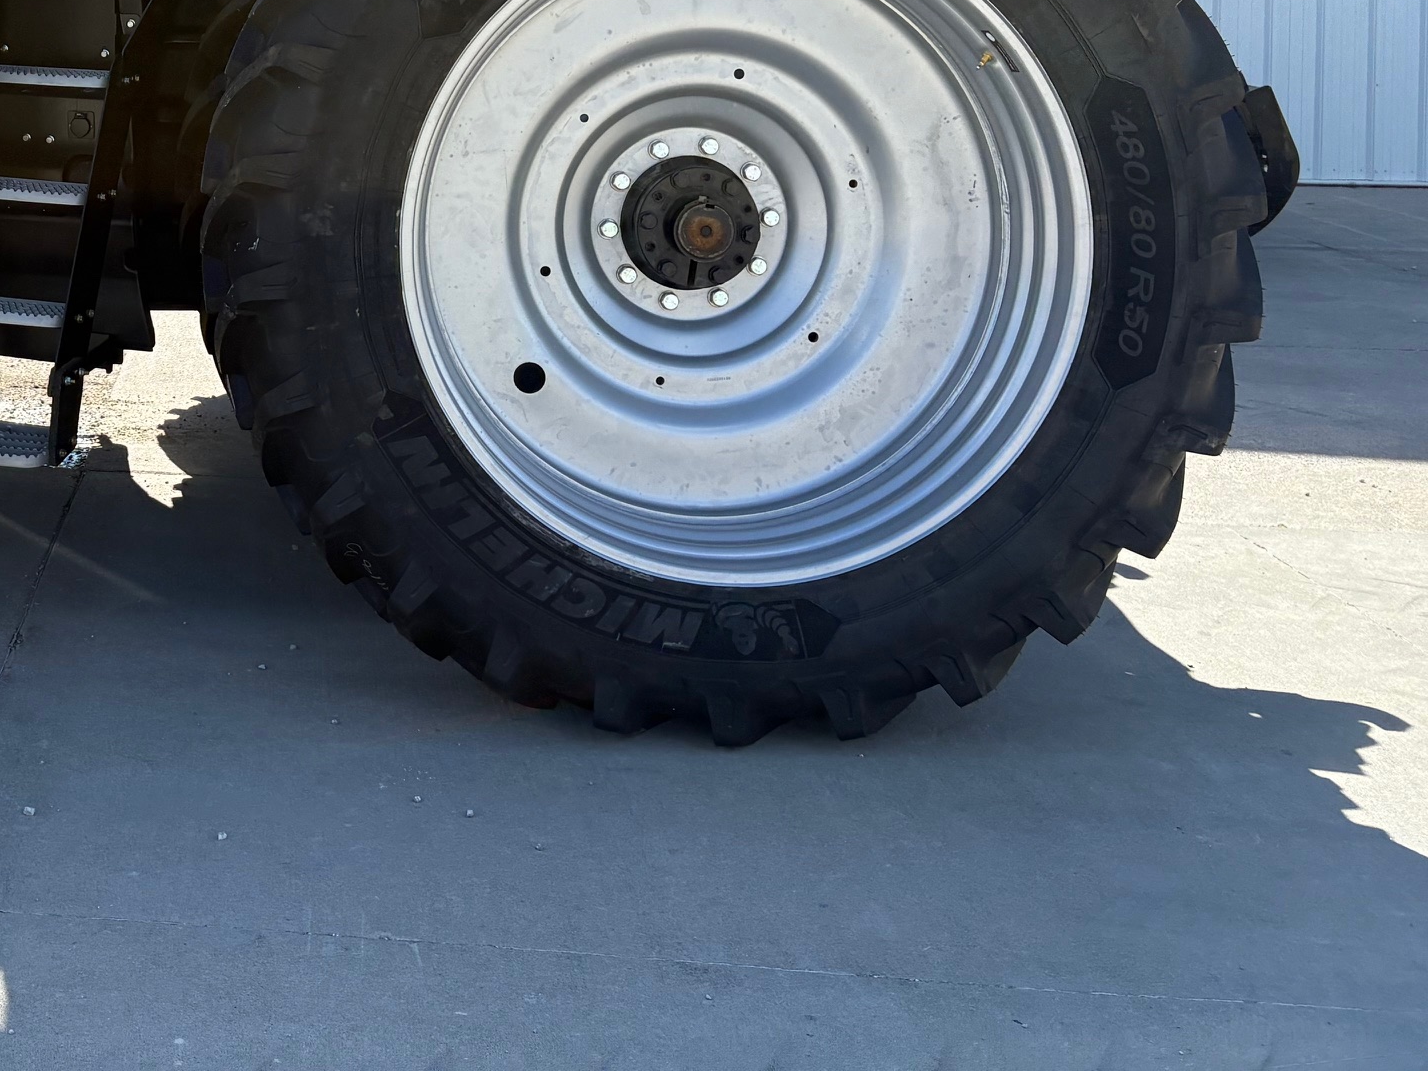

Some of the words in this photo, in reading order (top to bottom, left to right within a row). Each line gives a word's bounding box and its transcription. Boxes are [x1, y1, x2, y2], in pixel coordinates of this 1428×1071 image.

[1110, 109, 1156, 260] 480/80
[1117, 266, 1155, 357] R50
[384, 435, 710, 653] MICHELIN
